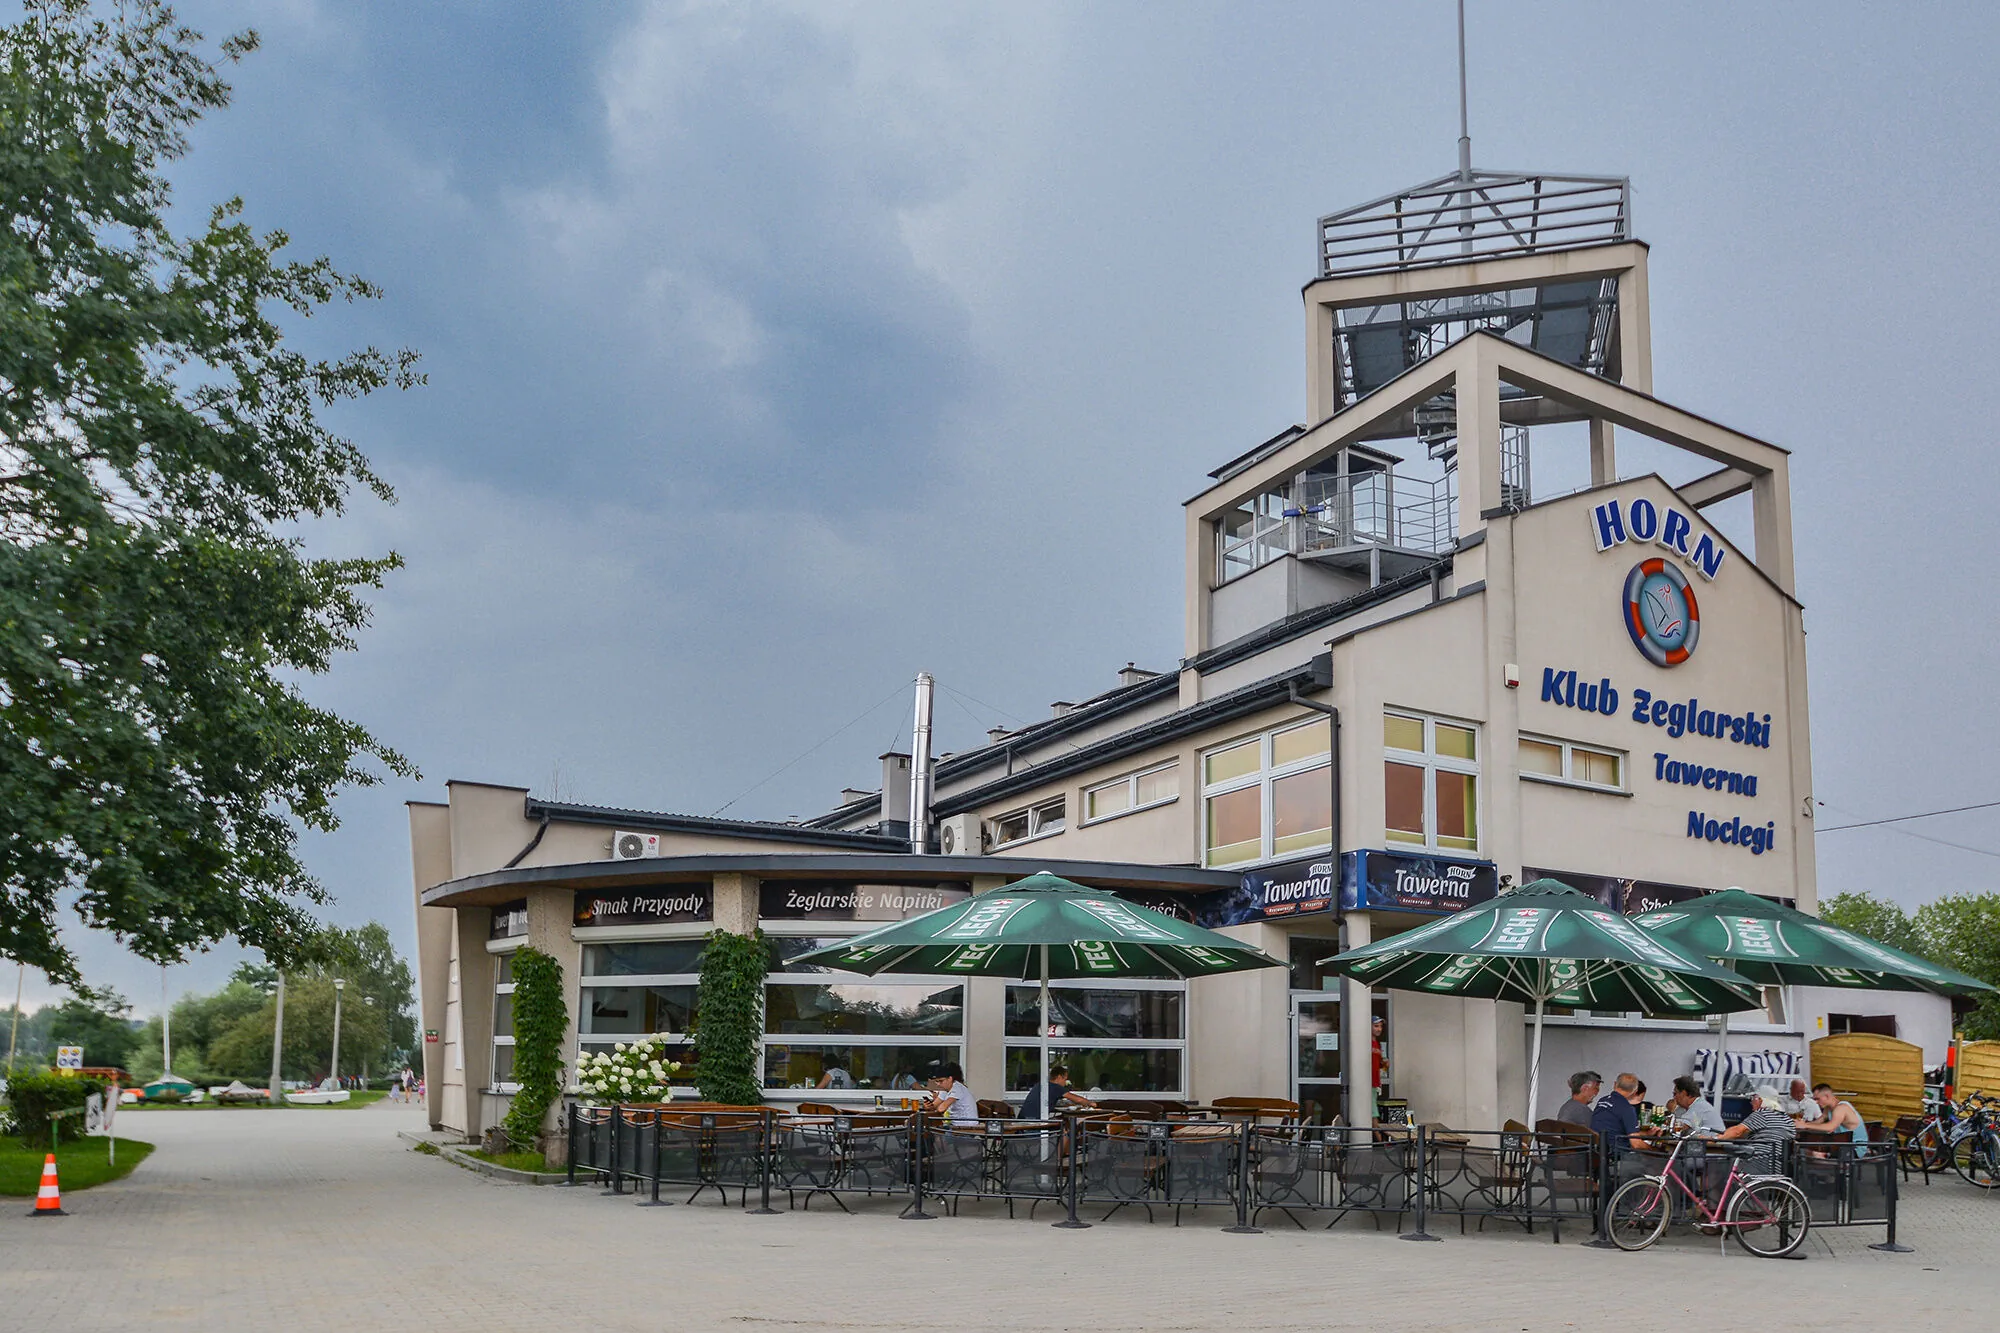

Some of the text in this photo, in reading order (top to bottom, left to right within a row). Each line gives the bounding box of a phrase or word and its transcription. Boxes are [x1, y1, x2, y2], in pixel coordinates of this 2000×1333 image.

[1592, 498, 1725, 580] HORN
[1541, 667, 1619, 716] Klub
[1654, 752, 1758, 797] Tawerna
[1687, 810, 1775, 855] Noclegi
[1312, 864, 1332, 875] HORN
[1395, 869, 1470, 898] Tawerna
[1450, 866, 1472, 879] HORN
[592, 893, 704, 916] Smak Przygody
[785, 889, 944, 912] Żeglarskie Napitki
[1263, 876, 1332, 904] Tawerna
[951, 905, 1010, 937] LECH
[1492, 918, 1540, 951] LECH
[1736, 923, 1776, 955] LECH
